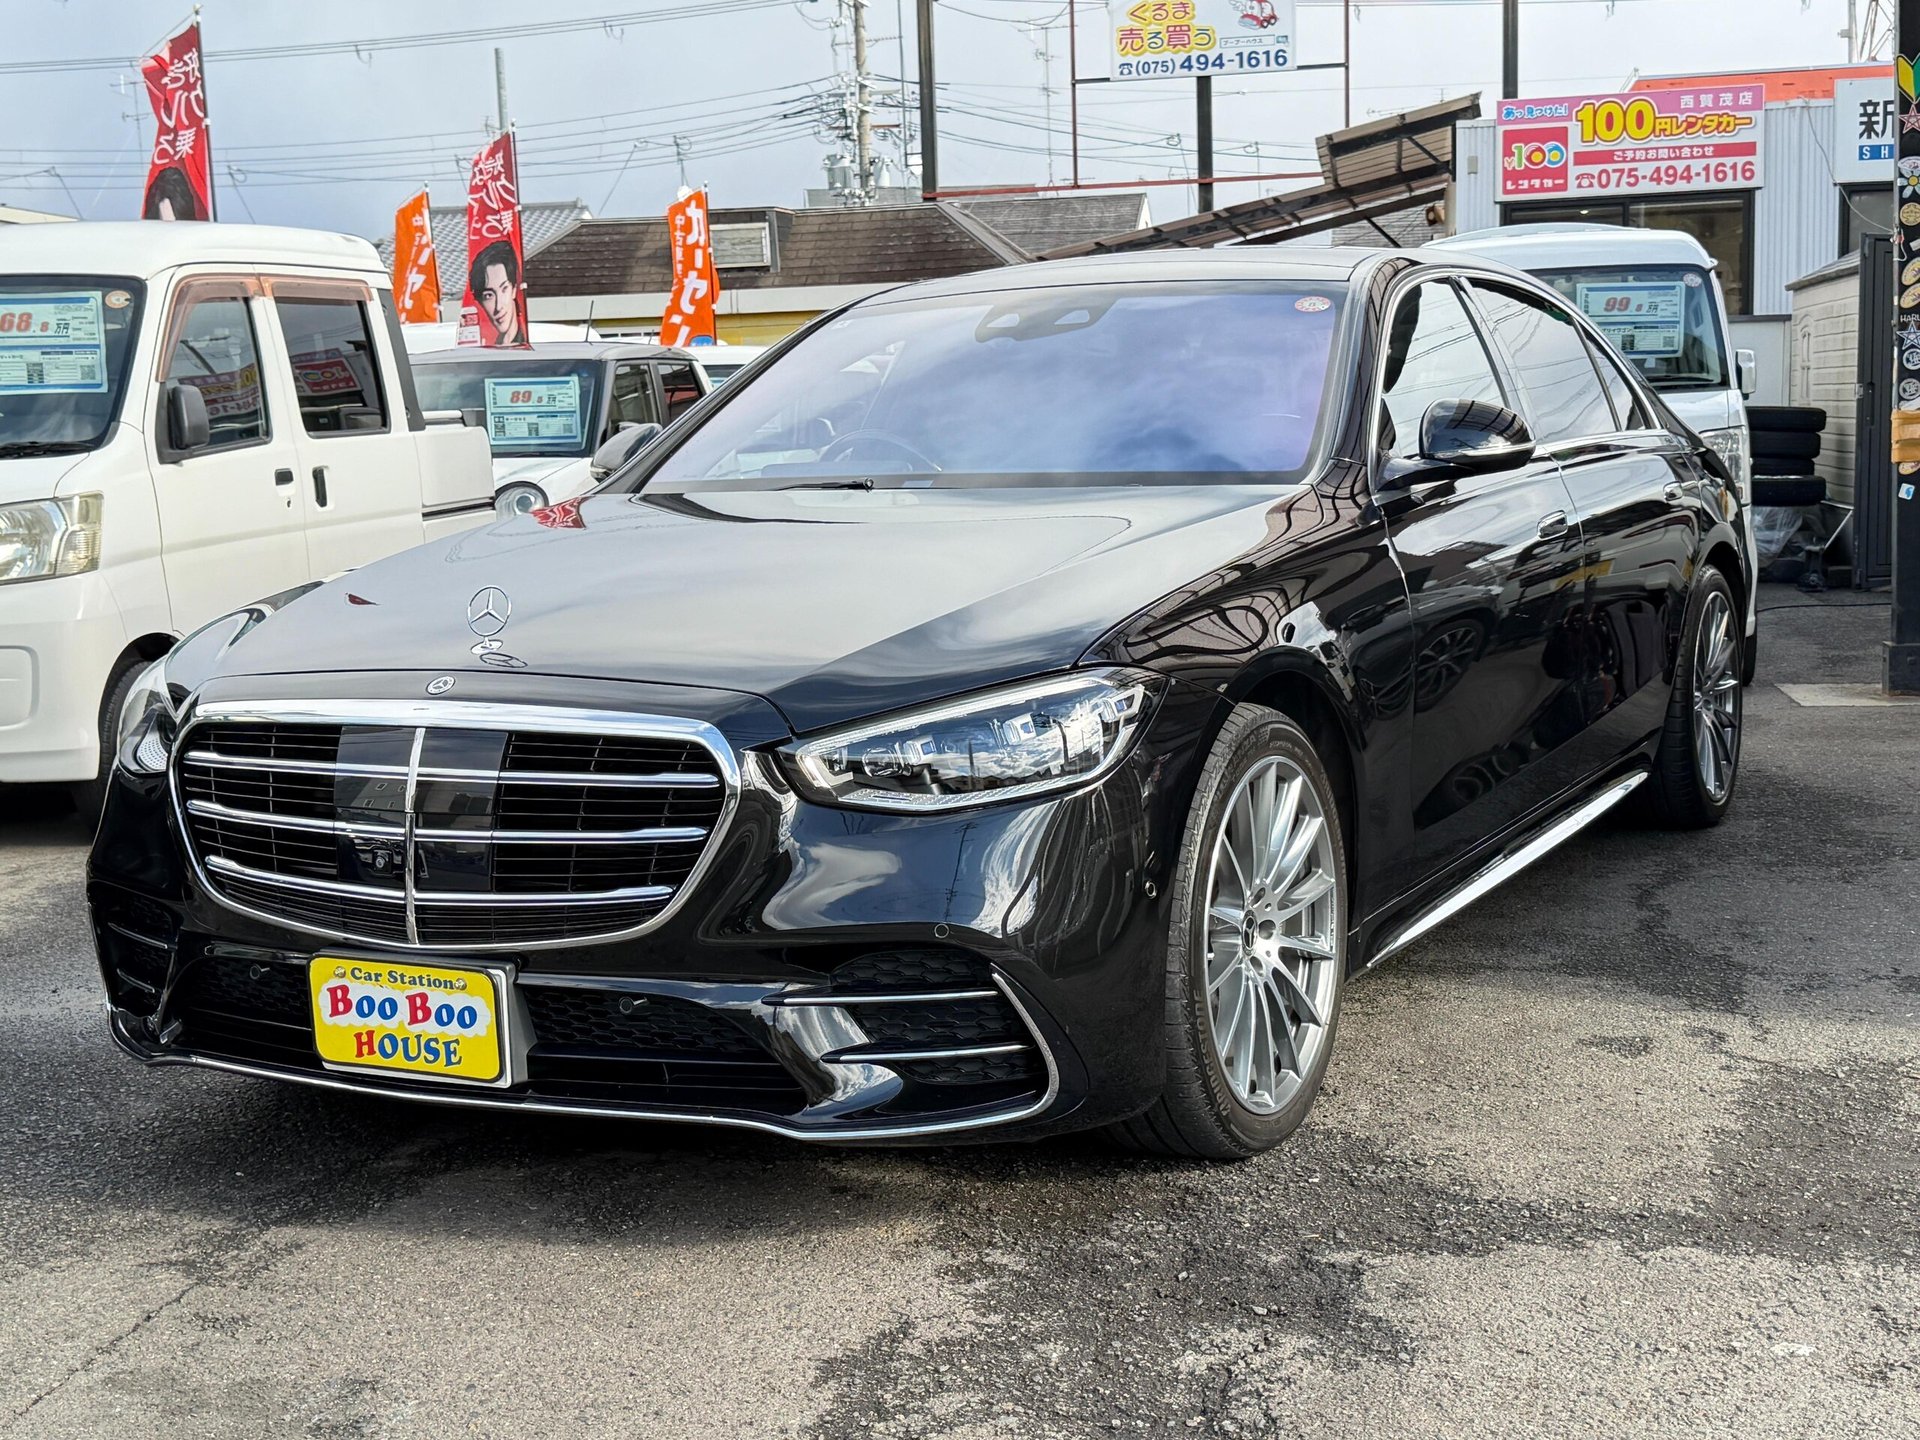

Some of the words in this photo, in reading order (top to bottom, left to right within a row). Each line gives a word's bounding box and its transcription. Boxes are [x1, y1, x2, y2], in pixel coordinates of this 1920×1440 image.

[1128, 1, 1192, 23] くるま
[1118, 24, 1214, 52] 売る買う
[1680, 91, 1754, 109] 西賀茂店
[1576, 99, 1754, 144] 100円レンタカー
[1859, 98, 1895, 140] 新
[1613, 146, 1715, 162] ご予約お問い合わせ
[1505, 178, 1565, 191] レンタカー
[1596, 161, 1756, 189] 075-494-1616
[350, 966, 384, 983] Car
[387, 969, 455, 990] Station
[353, 1029, 464, 1068] HOUSE
